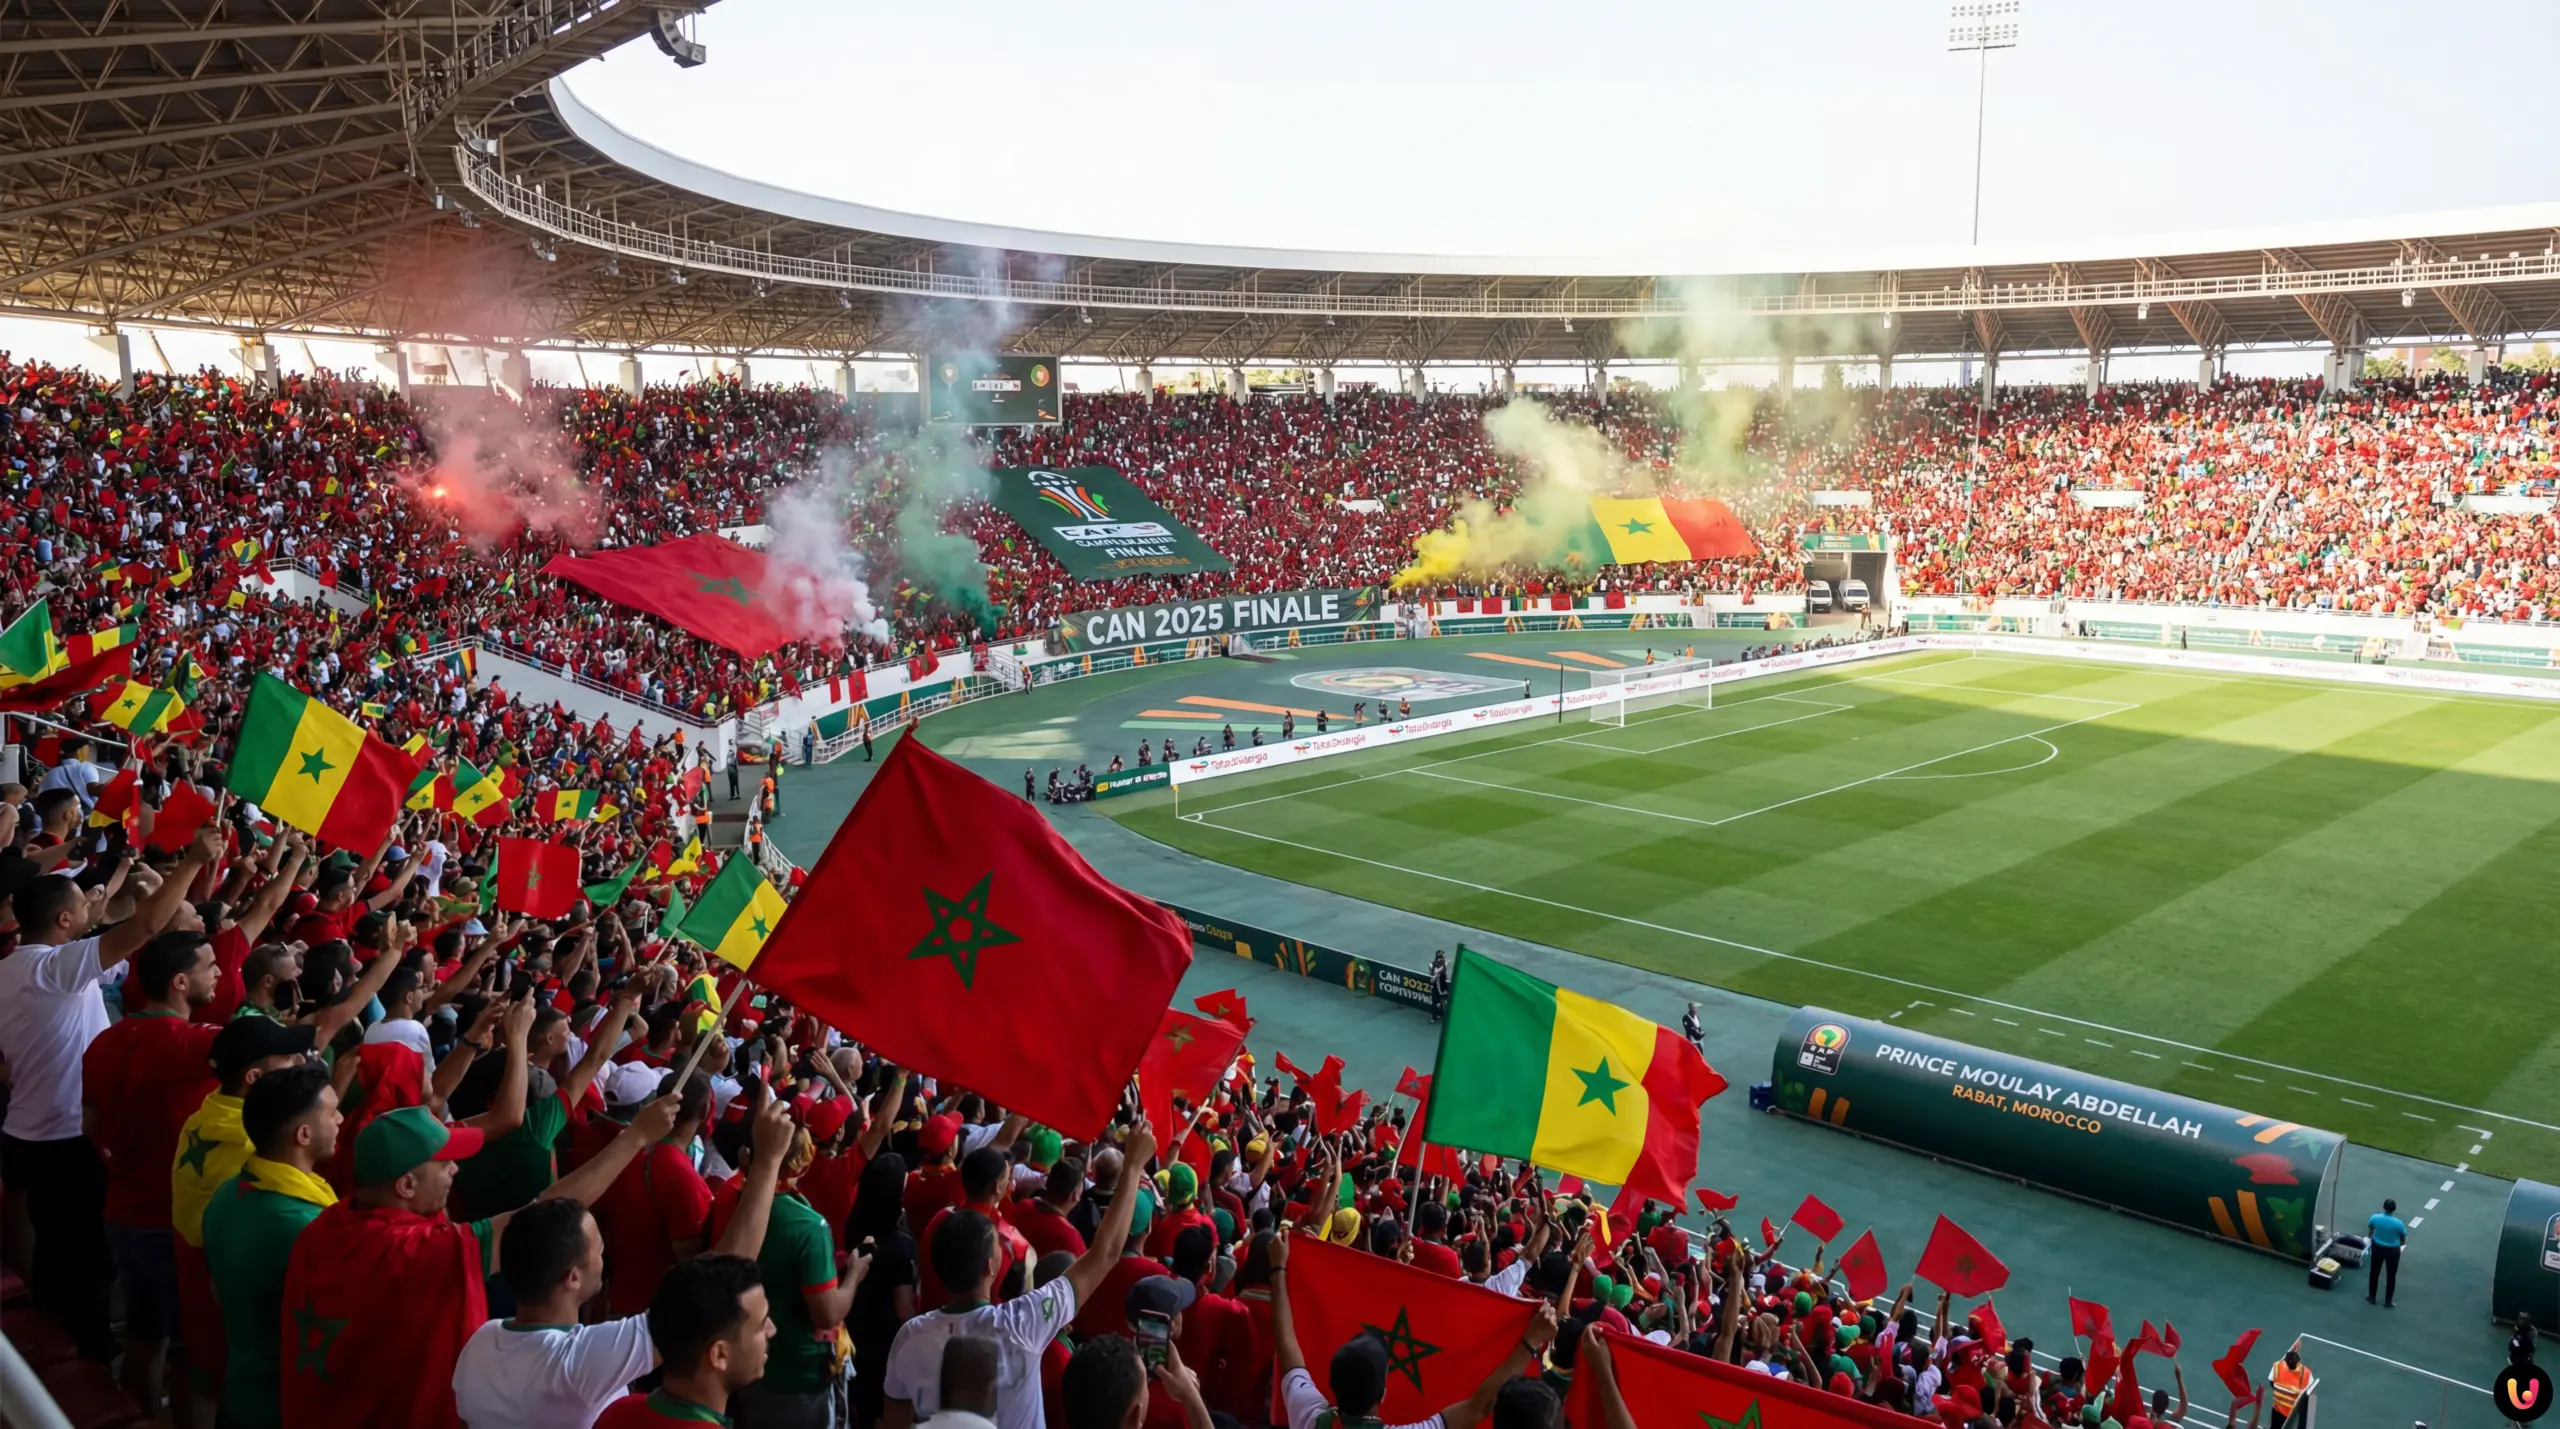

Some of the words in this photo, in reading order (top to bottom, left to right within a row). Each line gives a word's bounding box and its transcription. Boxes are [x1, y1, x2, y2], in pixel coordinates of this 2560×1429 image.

[1104, 545, 1175, 559] FINALE
[1086, 611, 1146, 646] CAN
[1154, 603, 1224, 637] 2025
[1233, 593, 1340, 628] FINALE
[1379, 970, 1401, 984] CAN
[1875, 1044, 1958, 1077] PRINCE
[1959, 1064, 2062, 1102] MOULAY
[2062, 1091, 2203, 1139] ABDELLAH
[1952, 1084, 2008, 1113] RABAT,
[2012, 1101, 2102, 1134] MOROCCO
